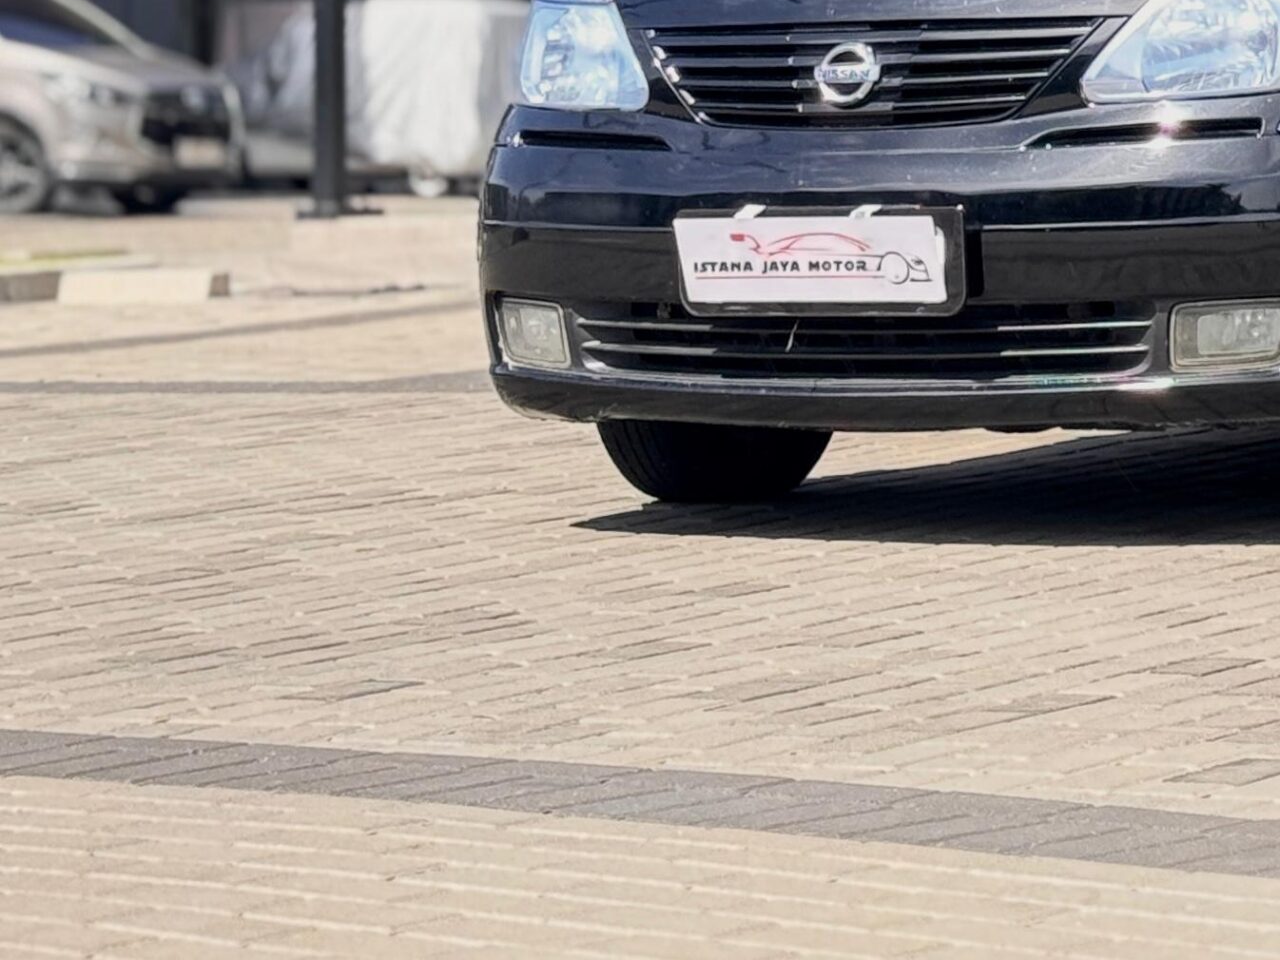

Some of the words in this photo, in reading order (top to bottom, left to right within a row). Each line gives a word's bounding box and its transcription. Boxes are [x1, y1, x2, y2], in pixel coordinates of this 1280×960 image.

[818, 69, 871, 81] NISSAN
[694, 261, 753, 274] ISTANA
[762, 261, 801, 274] JAYA
[808, 260, 868, 272] MOTOR
